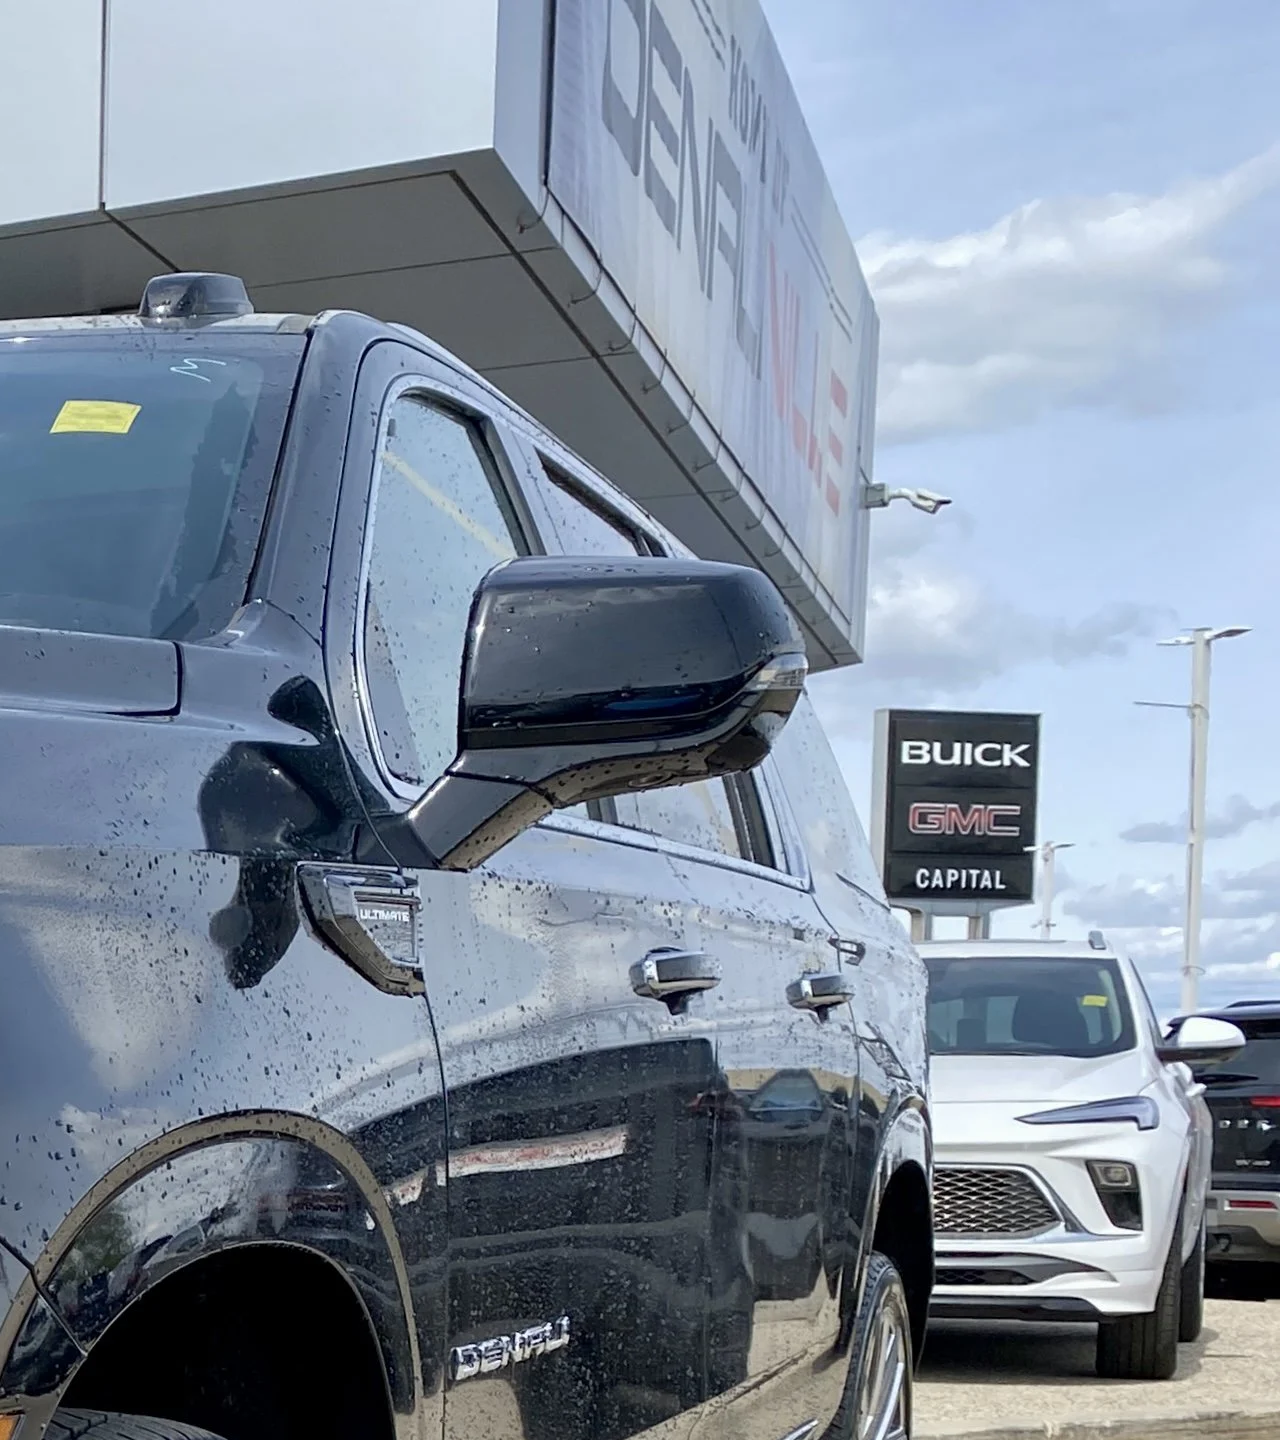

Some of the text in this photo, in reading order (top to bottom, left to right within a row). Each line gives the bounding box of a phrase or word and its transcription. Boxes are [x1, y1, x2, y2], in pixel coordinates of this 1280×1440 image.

[900, 740, 1032, 768] BUICK
[909, 802, 1021, 837] GMC
[915, 867, 1007, 890] CAPITAL
[359, 908, 410, 922] ULTIMATE
